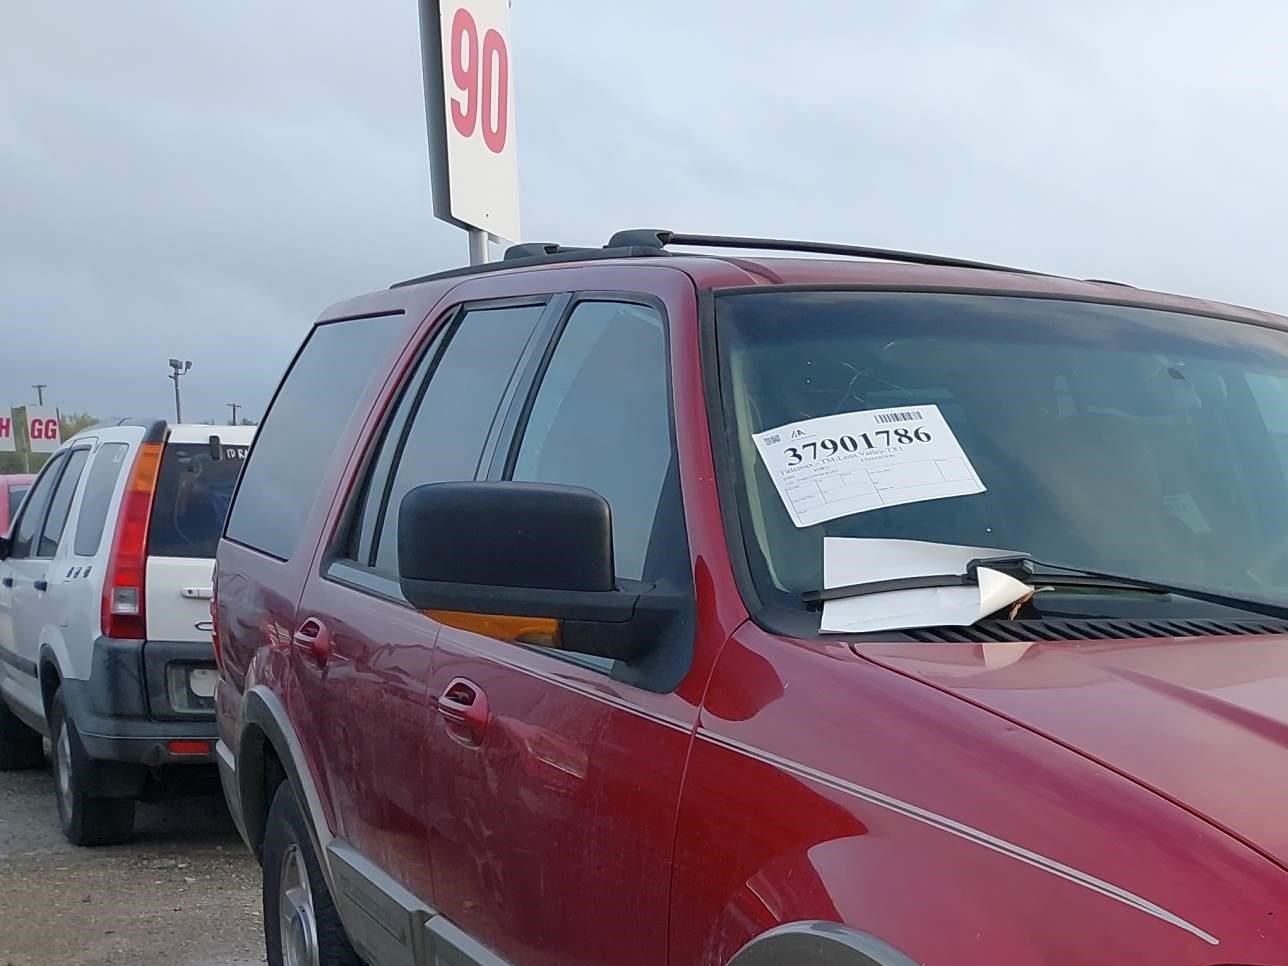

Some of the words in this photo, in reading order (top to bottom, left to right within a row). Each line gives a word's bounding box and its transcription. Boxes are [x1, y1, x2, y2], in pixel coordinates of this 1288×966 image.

[450, 8, 508, 154] 90
[30, 418, 58, 440] GG
[783, 425, 932, 467] 37901786
